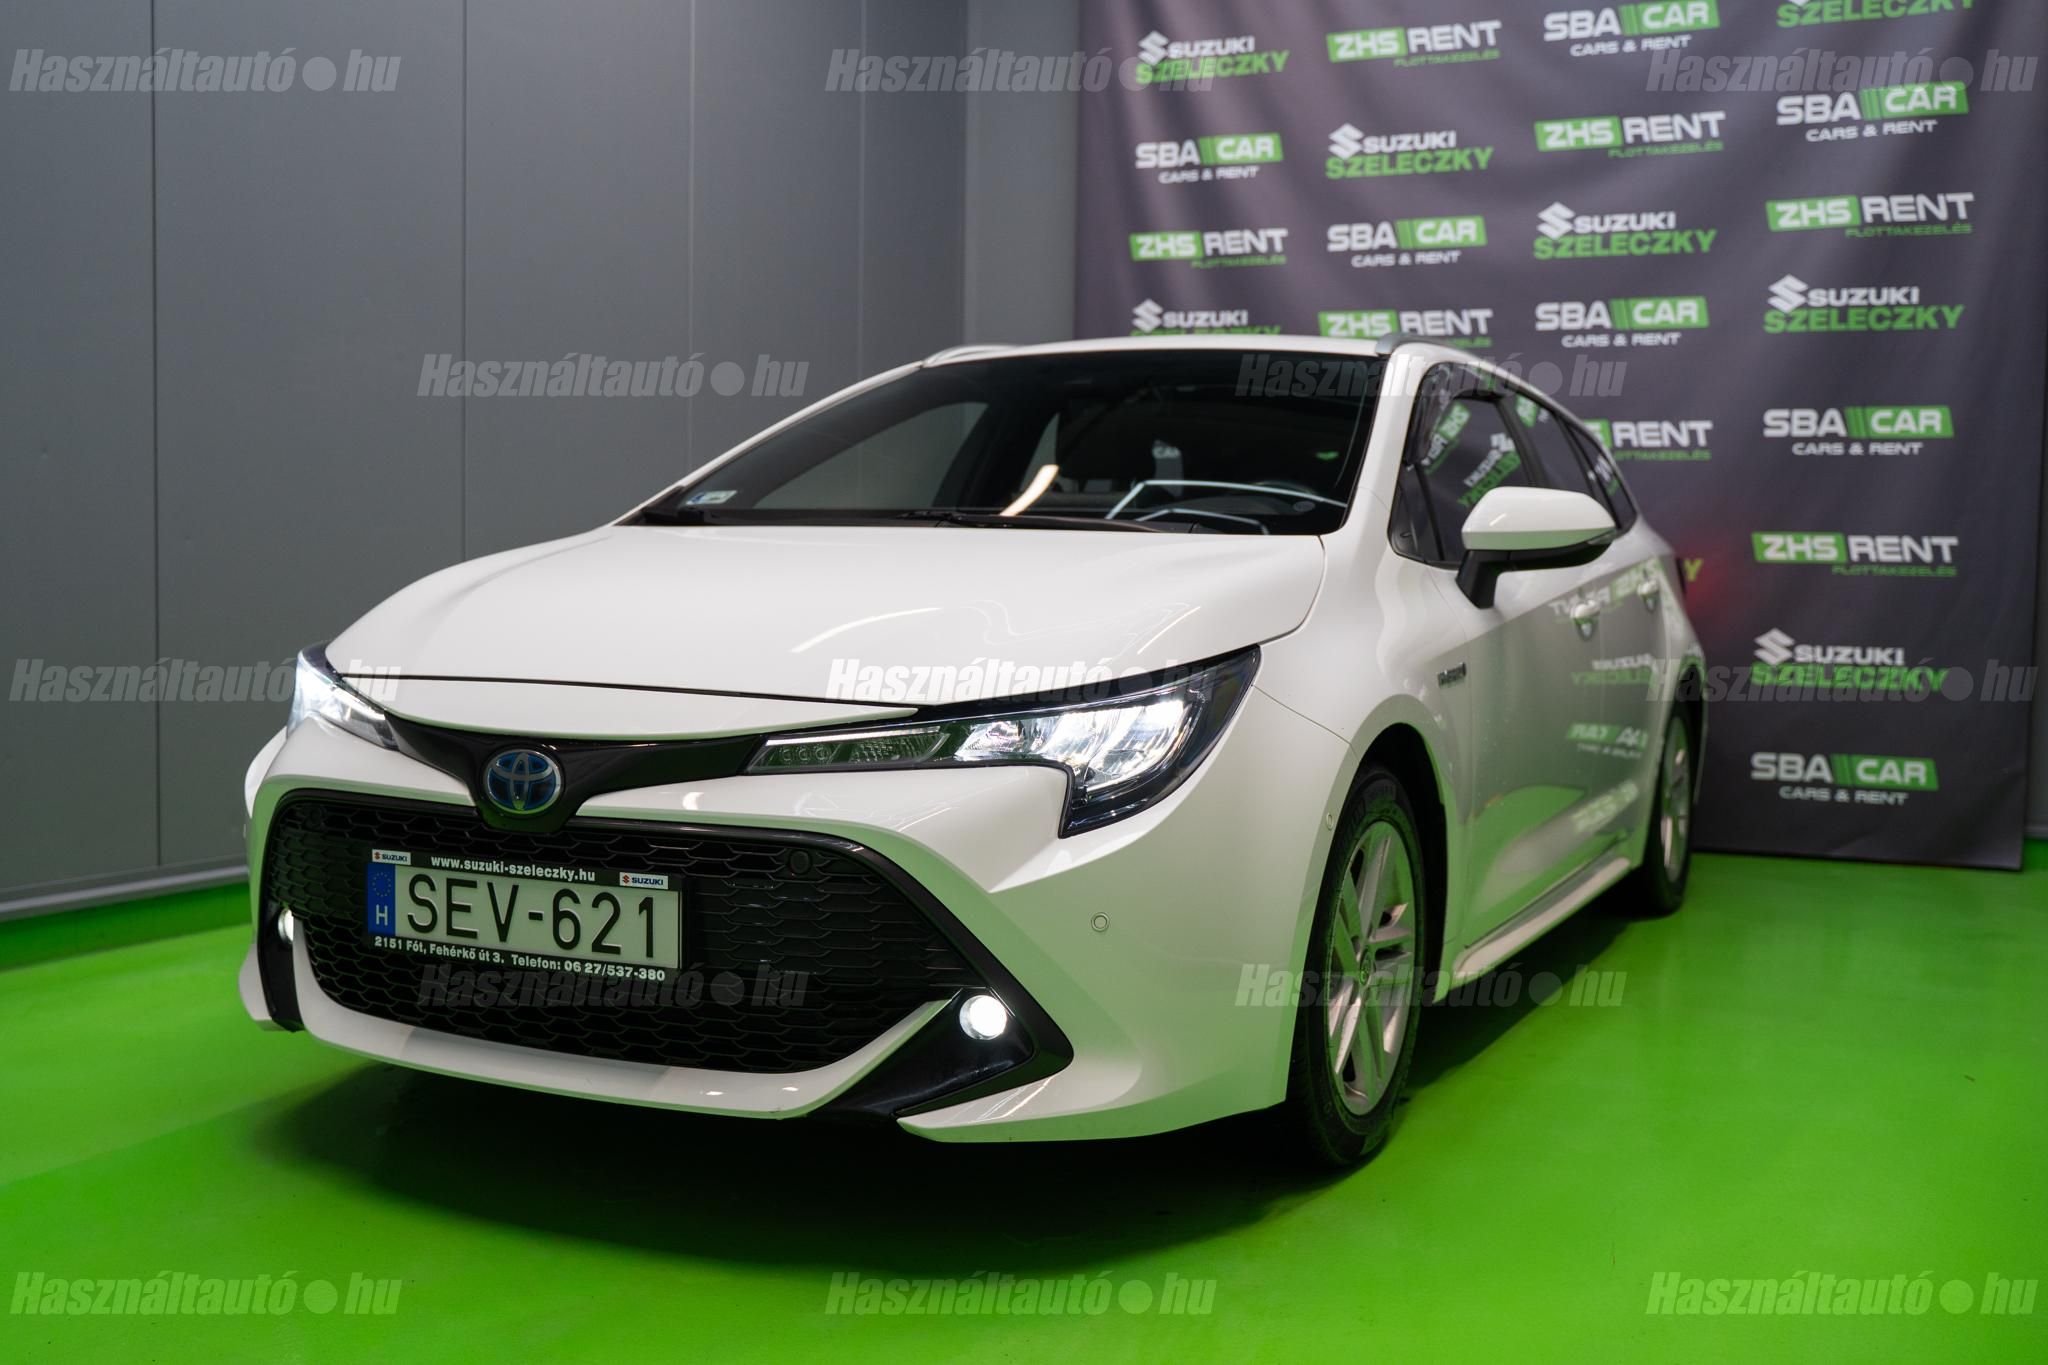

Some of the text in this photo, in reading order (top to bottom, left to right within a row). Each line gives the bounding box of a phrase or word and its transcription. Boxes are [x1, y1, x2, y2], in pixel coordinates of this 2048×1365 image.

[1544, 2, 1710, 41] SBA CAR
[1168, 35, 1255, 58] SUZUKI
[1333, 20, 1502, 59] ZHS RENT
[1570, 34, 1692, 57] CARS & RENT
[1136, 50, 1290, 84] SZELECZKY
[1776, 85, 1957, 125] SBA CAR
[1363, 130, 1457, 153] SUZUKI
[1543, 111, 1726, 148] ZHS RENT
[1805, 119, 1938, 142] CARS & RENT
[1135, 136, 1274, 169] SBA CAR
[1326, 146, 1494, 179] SZELECZKY
[1158, 169, 1199, 184] CARS
[1216, 165, 1260, 179] RENT
[1574, 211, 1676, 233] SUZUKI
[1775, 192, 1974, 228] ZHS RENT
[1136, 228, 1288, 258] ZHS RENT
[1327, 219, 1477, 251] SBA CAR
[1533, 228, 1717, 260] SZELECZKY
[1351, 250, 1461, 268] CARS & RENT
[1807, 286, 1920, 307] SUZUKI
[1162, 310, 1248, 328] SUZUKI
[1326, 308, 1493, 336] ZHS RENT
[1535, 300, 1699, 331] SBA CAR
[1763, 304, 1965, 334] SZELECZKY
[1561, 332, 1681, 348] CARS & RENT
[1612, 420, 1713, 447] RENT
[1763, 407, 1942, 438] SBA CAR
[1792, 442, 1924, 456] CARS & RENT
[1761, 535, 1959, 563] ZHS RENT
[1794, 644, 1905, 666] SUZUKI
[1751, 662, 1949, 693] SZELECZKY
[1751, 752, 1927, 785] SBA CAR
[1779, 785, 1909, 805] CARS & RENT
[382, 853, 408, 862] SUZUKI
[431, 856, 595, 881] www.suzuki-szeleczky.hu
[631, 877, 664, 886] SUZUKI
[375, 904, 388, 926] H
[407, 873, 654, 958] SEV-621
[374, 936, 665, 981] 2151 Fót, Fehérkő út 3. Telefon: 06 27/537-380
